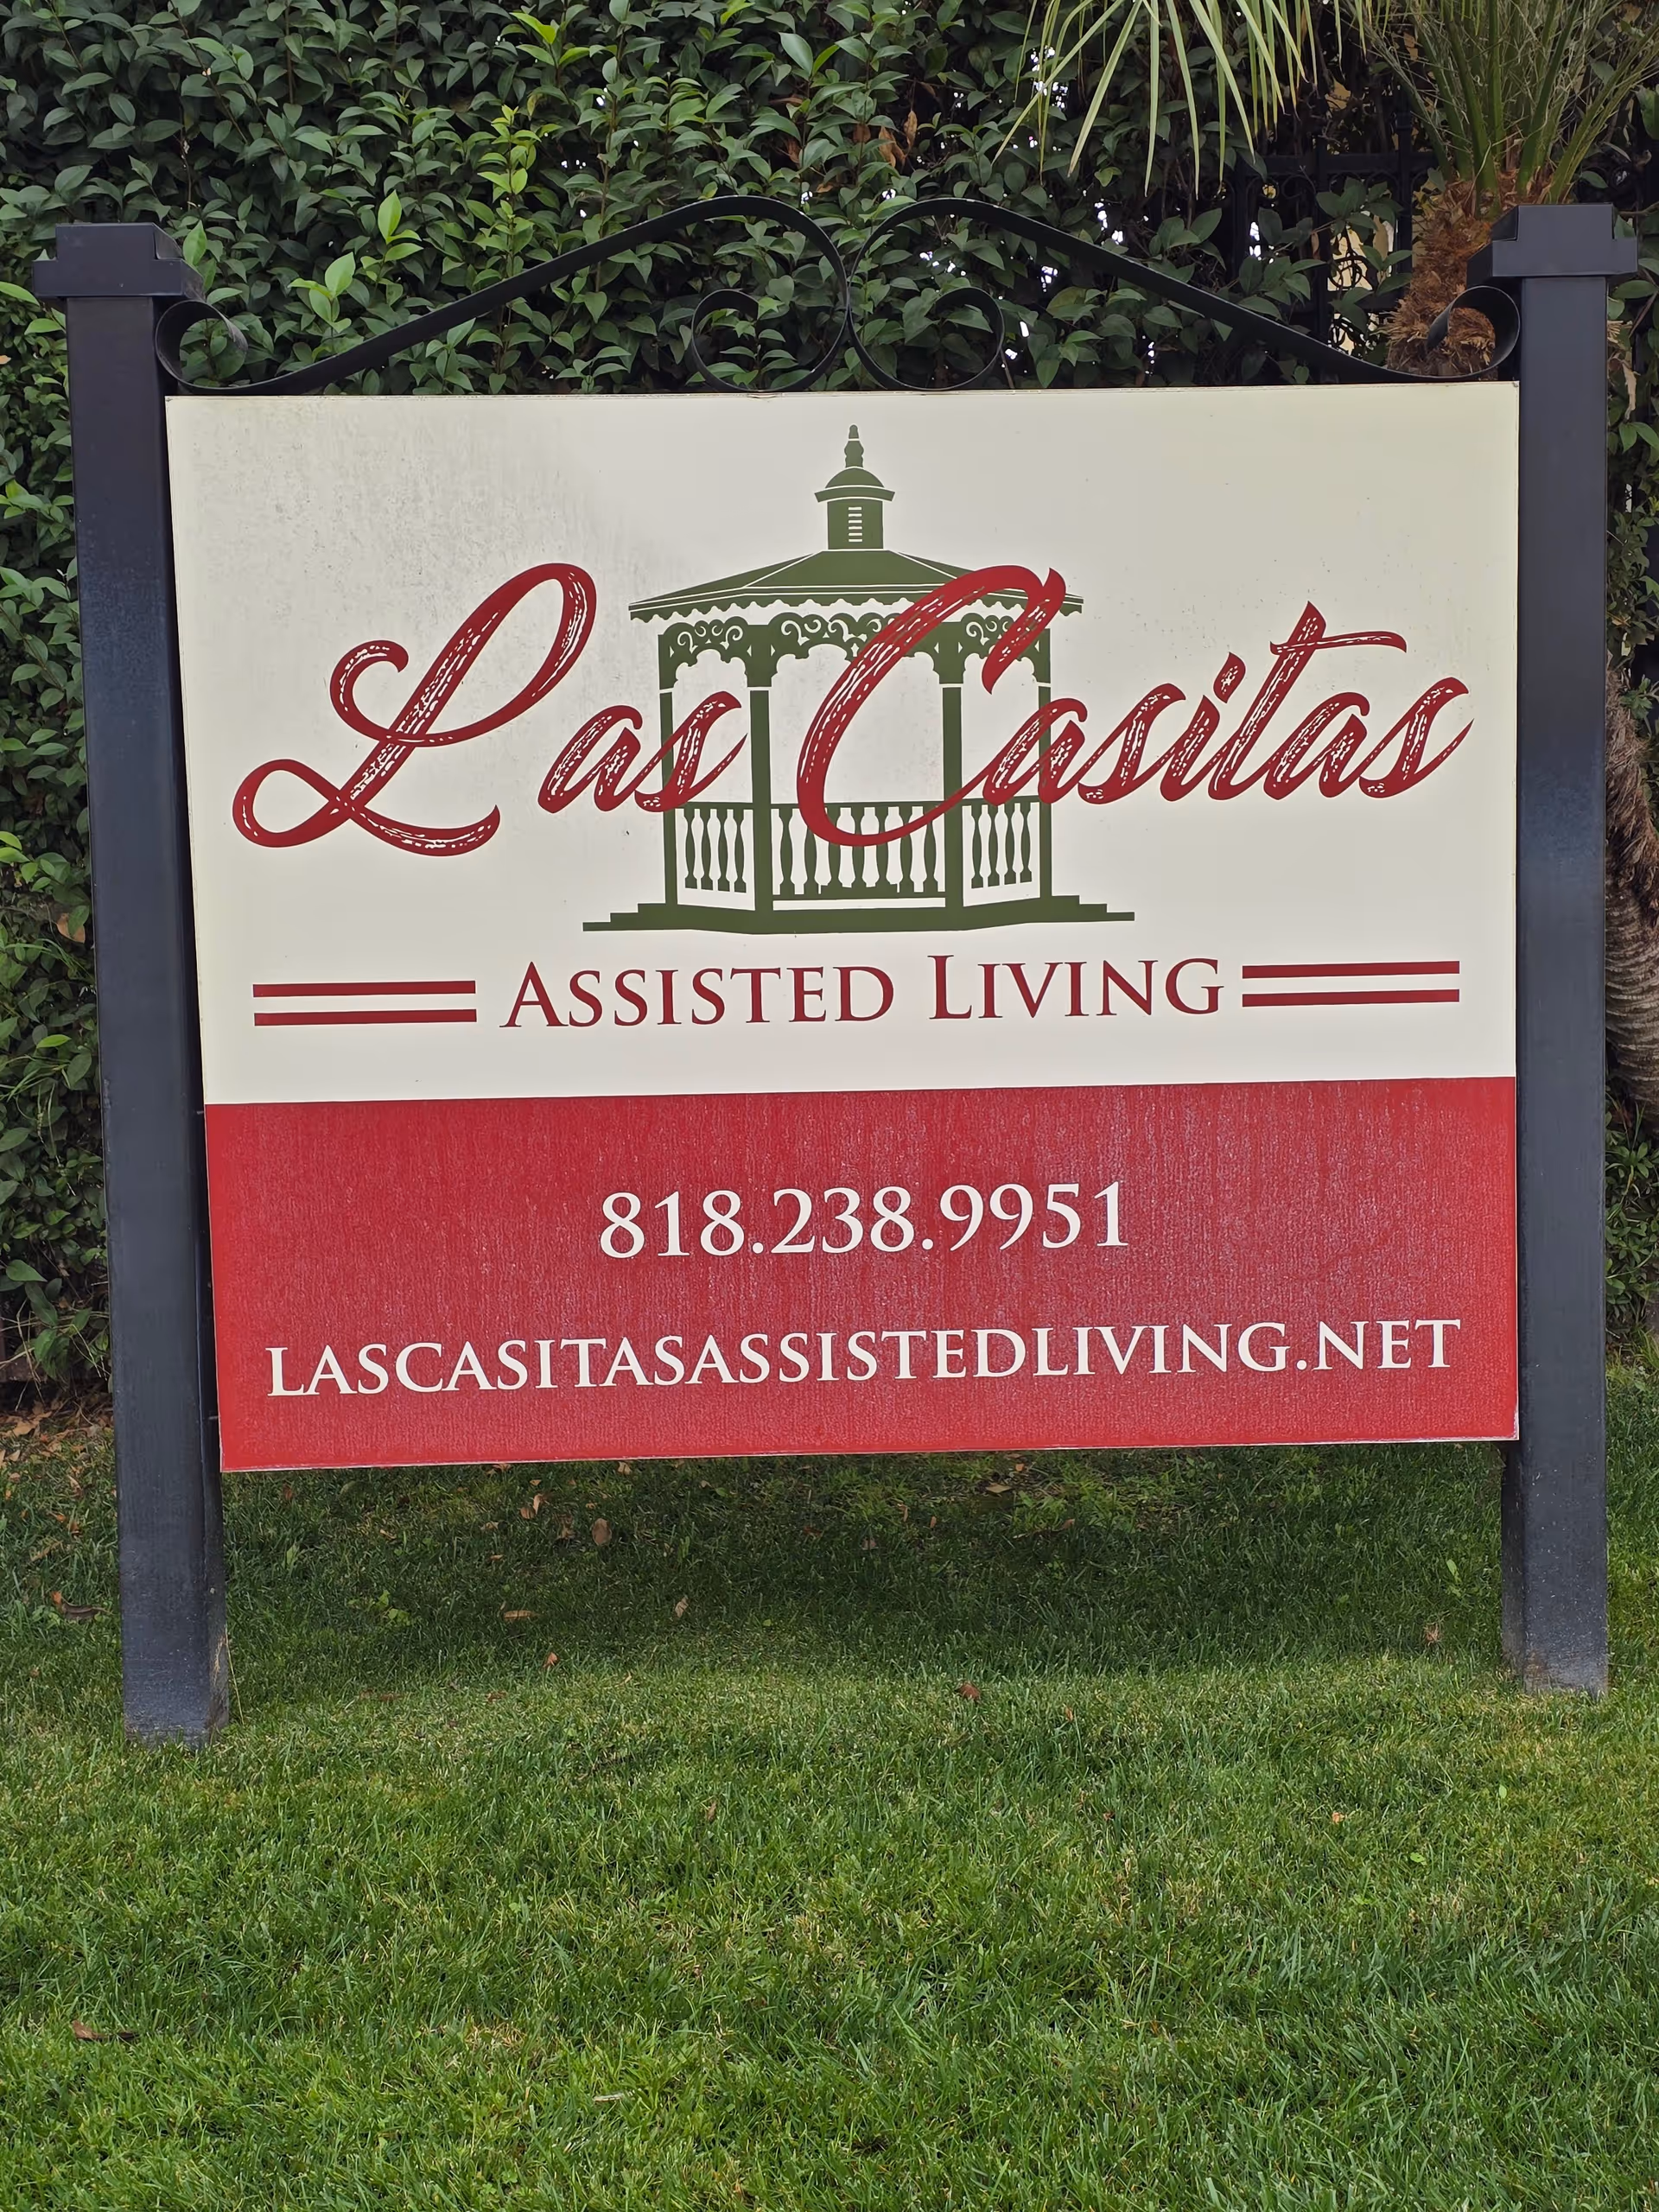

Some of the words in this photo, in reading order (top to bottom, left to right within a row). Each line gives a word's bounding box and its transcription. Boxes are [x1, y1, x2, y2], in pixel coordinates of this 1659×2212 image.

[232, 563, 747, 857] Las
[797, 564, 1475, 848] Casitas
[499, 963, 894, 1028] ASSISTED
[928, 955, 1225, 1019] LIVING
[599, 1181, 1130, 1260] 818.238.9951
[265, 1318, 1463, 1397] LASCASITASASSISTEDLIVING.NET
